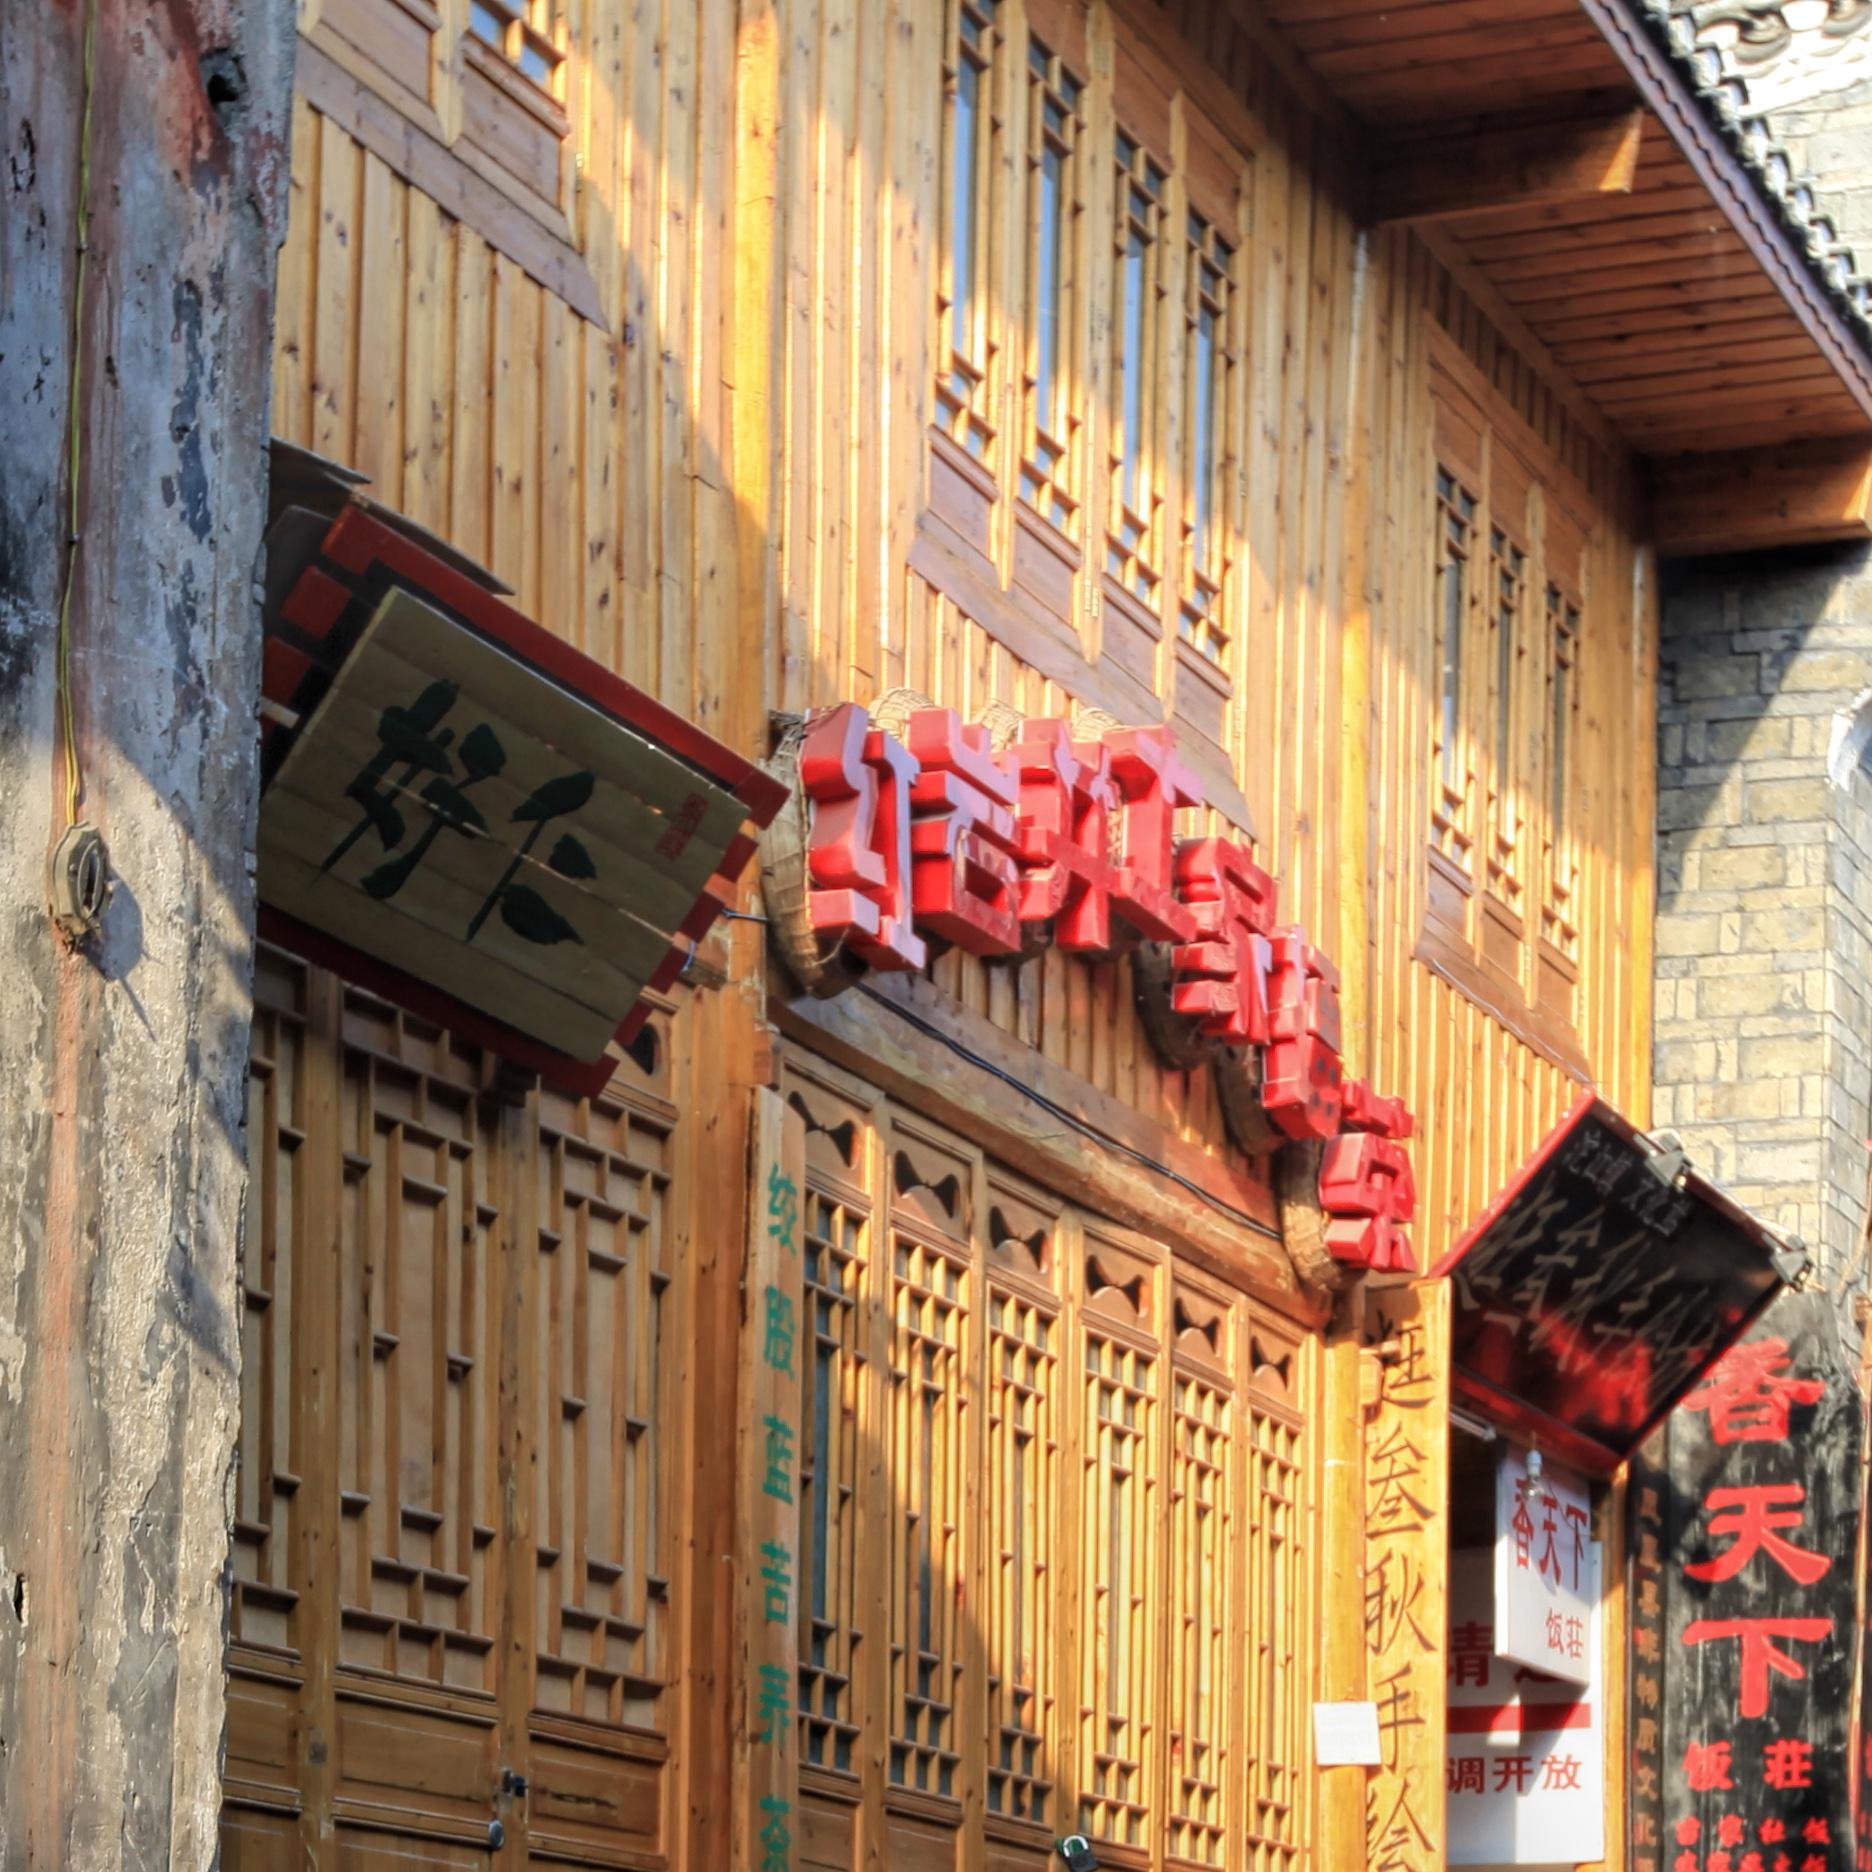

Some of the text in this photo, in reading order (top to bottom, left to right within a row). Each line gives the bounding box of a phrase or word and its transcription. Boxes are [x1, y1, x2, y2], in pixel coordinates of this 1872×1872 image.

[1512, 1477, 1588, 1591] 香天下
[1681, 1335, 1834, 1719] 香天下
